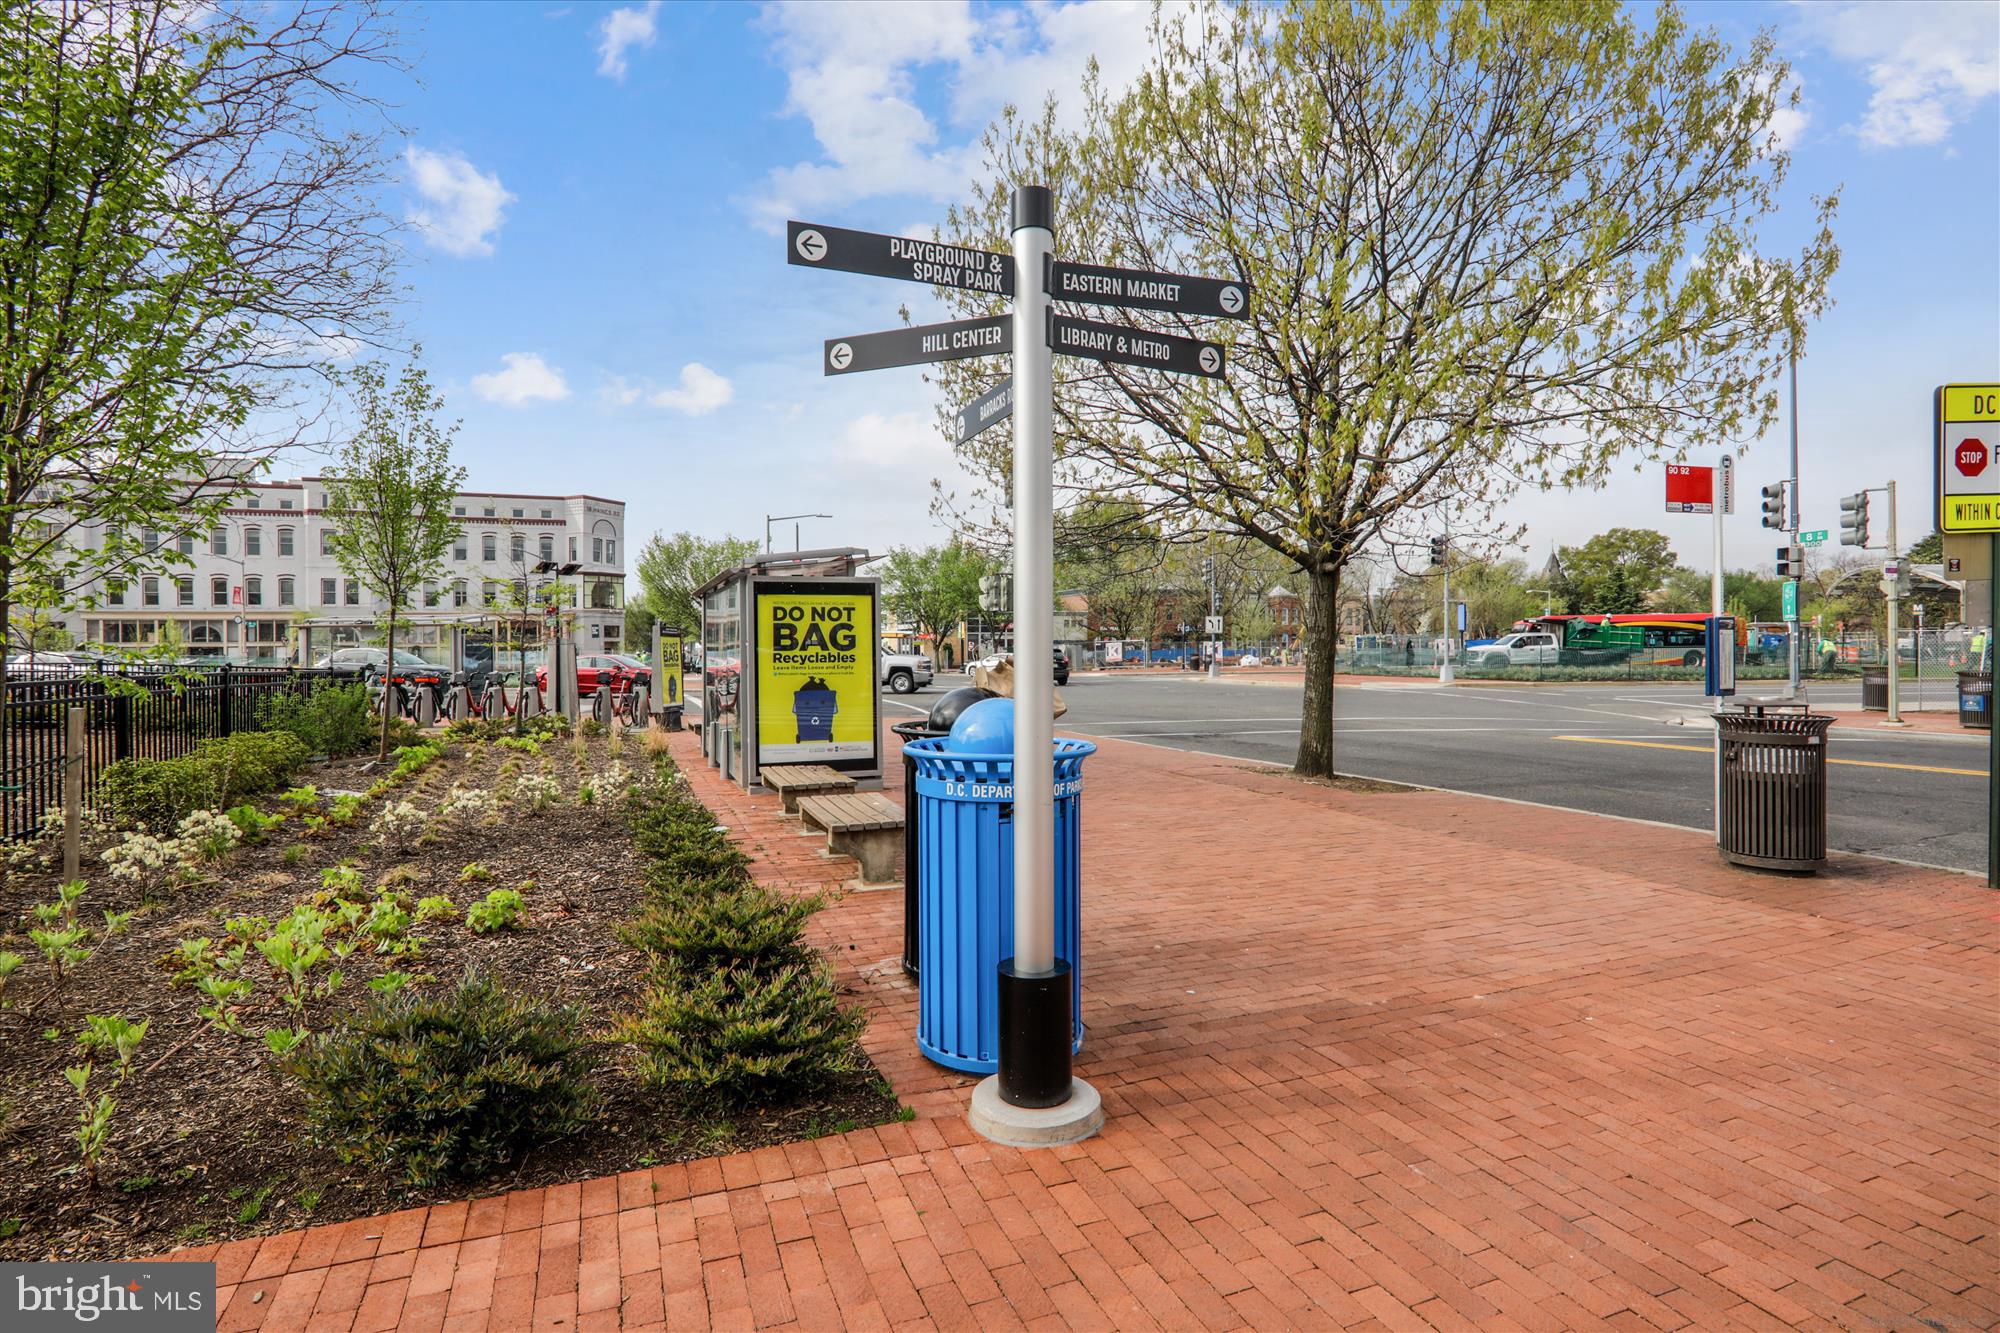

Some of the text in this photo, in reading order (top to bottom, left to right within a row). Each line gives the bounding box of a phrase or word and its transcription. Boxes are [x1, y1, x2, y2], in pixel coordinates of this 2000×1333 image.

[891, 238, 1002, 273] PLAYGROUND &
[913, 262, 1002, 292] SPRAY PARK
[1063, 272, 1180, 302] EASTERN MARKET
[922, 326, 1002, 353] HILL CENTER
[1061, 326, 1170, 361] LIBRARY & METRO
[1974, 395, 1996, 414] DC
[1960, 451, 1982, 464] STOP
[1668, 466, 1690, 475] 90 92
[1956, 503, 1991, 521] WITHIN
[773, 606, 856, 622] DO NOT
[773, 623, 856, 652] BAG
[663, 650, 679, 662] BAG
[773, 652, 856, 665] Recyclables
[946, 783, 968, 797] D.C.
[1053, 783, 1065, 796] OF
